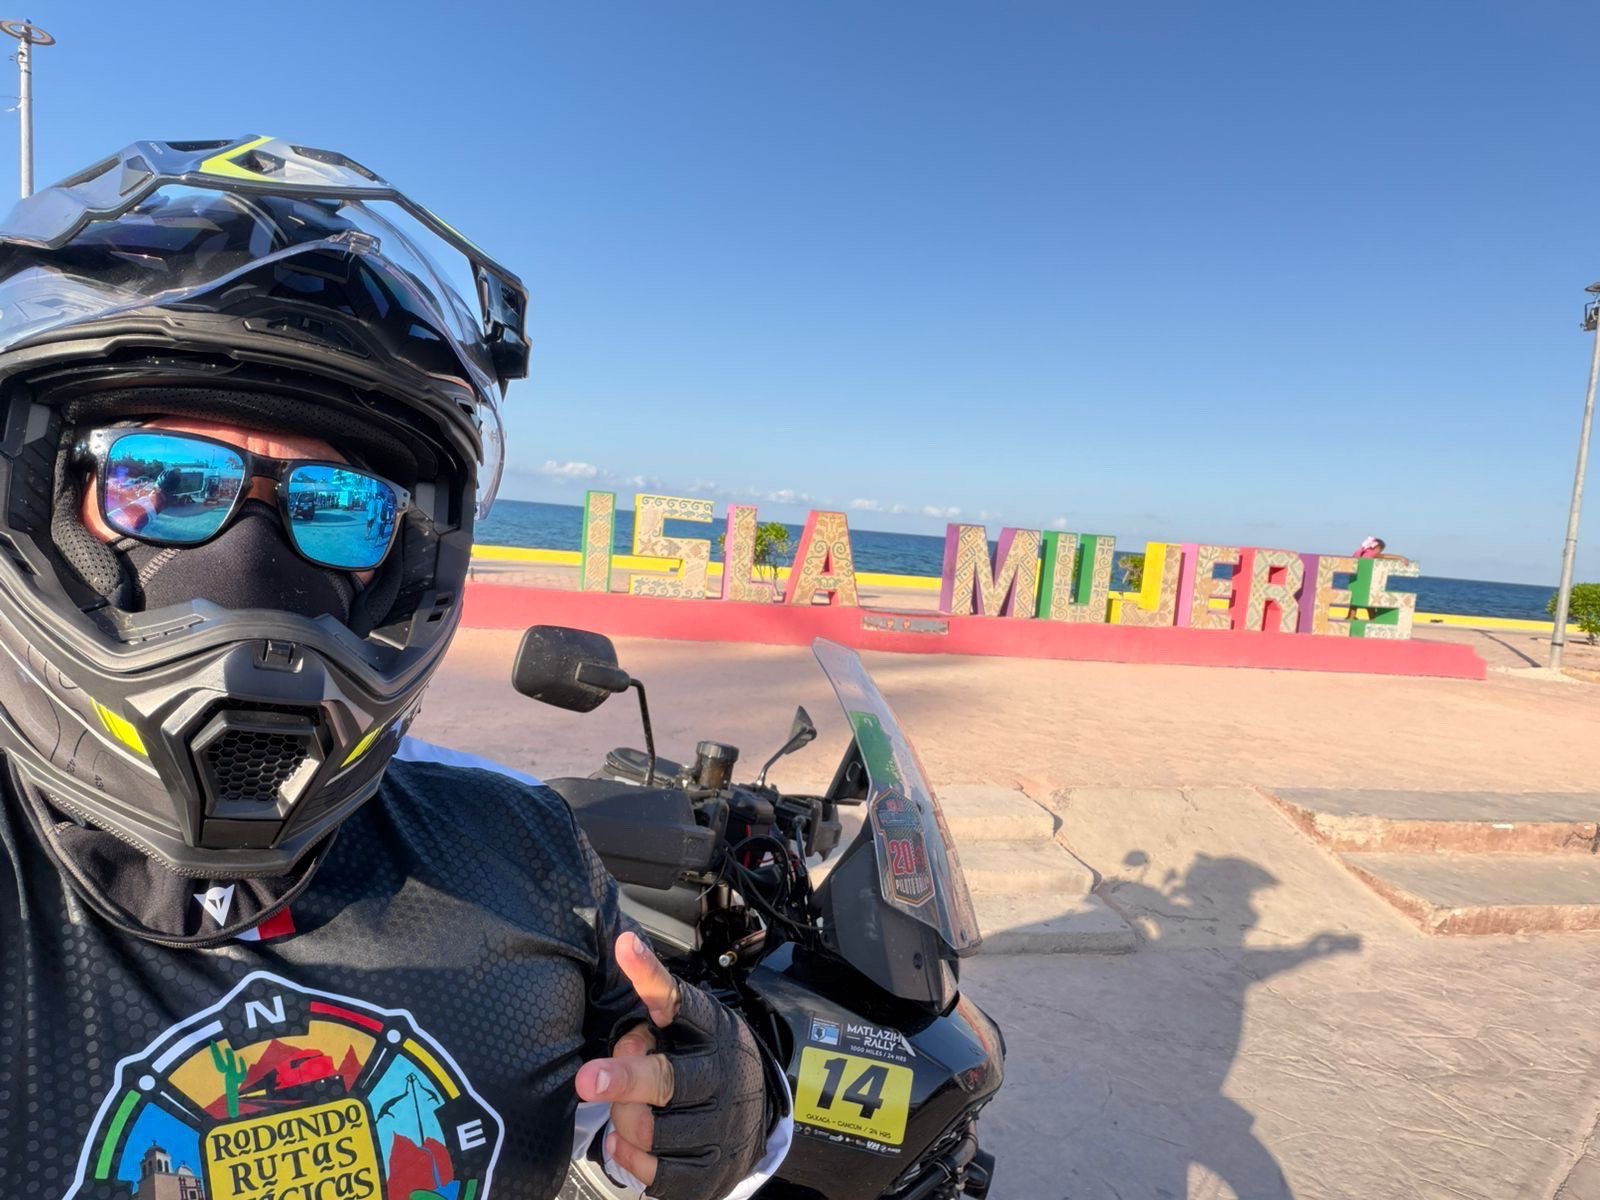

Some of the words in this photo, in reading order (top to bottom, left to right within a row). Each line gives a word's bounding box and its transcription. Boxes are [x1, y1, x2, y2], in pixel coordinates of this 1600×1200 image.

[580, 490, 861, 607] ISLA
[939, 523, 1420, 640] MUJERES
[244, 995, 286, 1029] N
[863, 1036, 897, 1052] RALLY
[865, 1048, 883, 1057] MILES
[895, 1055, 907, 1063] HRS
[816, 1057, 890, 1120] 14
[457, 1119, 485, 1152] E
[806, 1113, 830, 1124] OAXACA
[869, 1127, 878, 1135] 24
[879, 1131, 892, 1139] HRS
